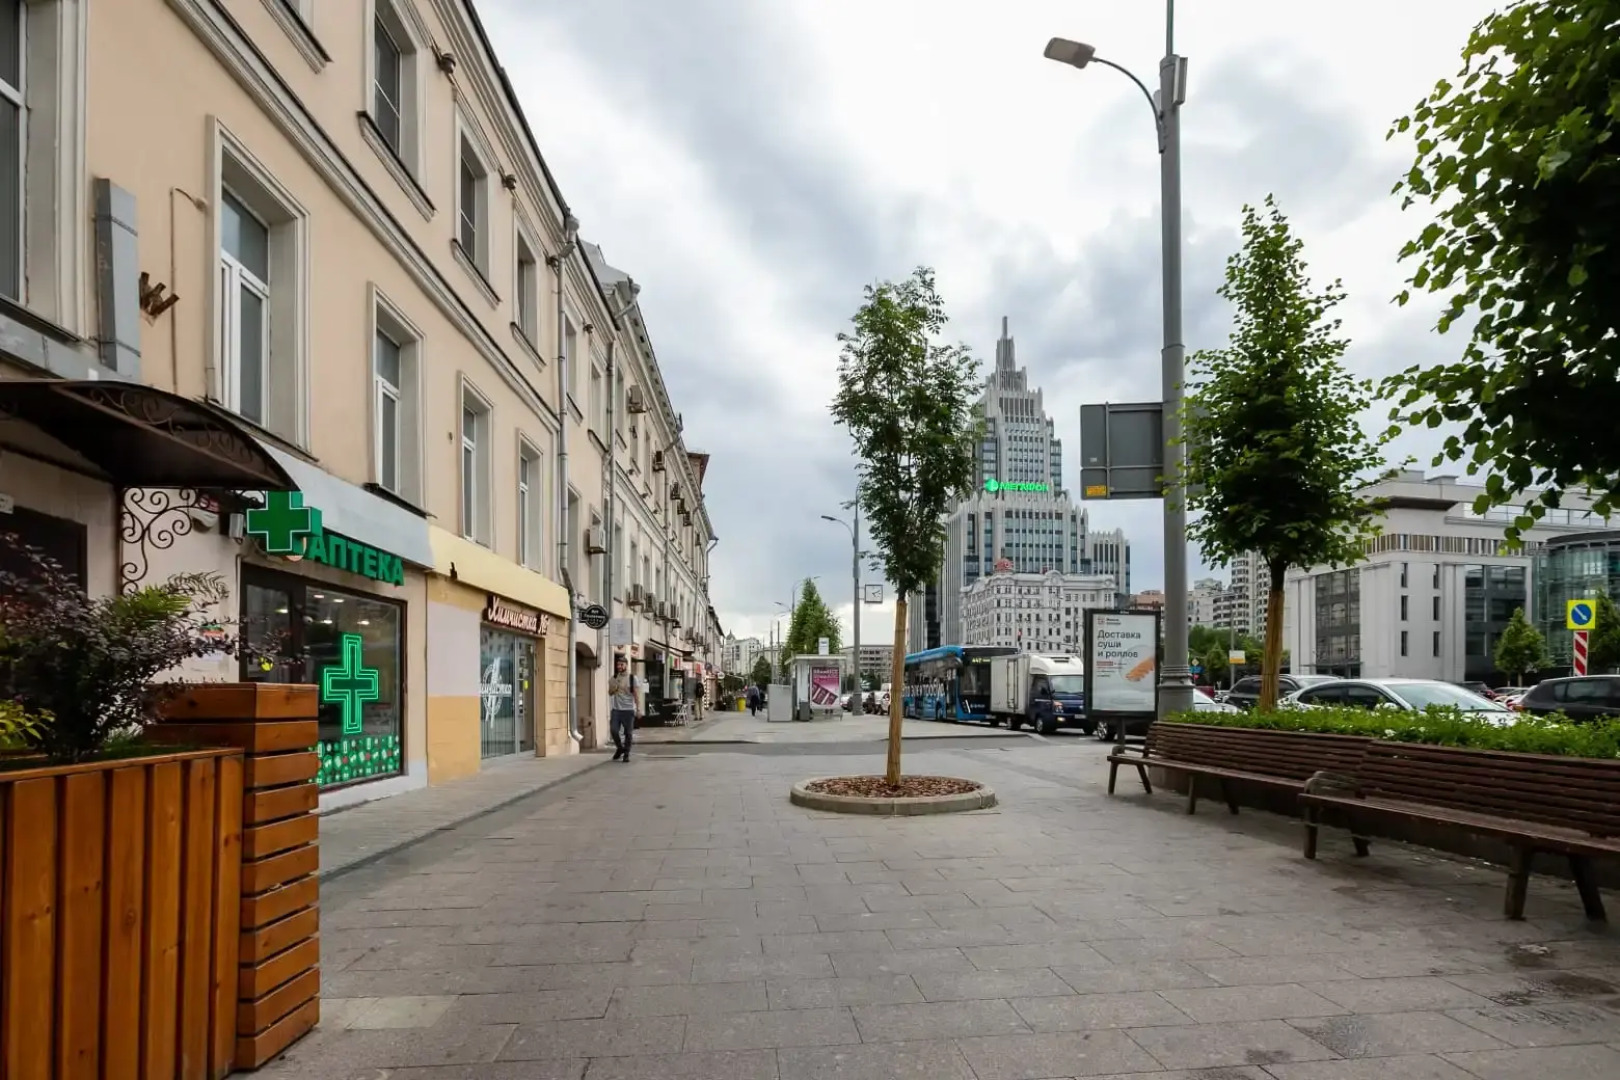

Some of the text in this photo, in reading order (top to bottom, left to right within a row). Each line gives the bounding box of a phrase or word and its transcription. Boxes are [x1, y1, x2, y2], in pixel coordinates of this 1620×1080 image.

[307, 535, 404, 585] АПТЕКА
[487, 596, 537, 632] Химчистка
[1097, 630, 1141, 639] Доставка
[1097, 641, 1122, 649] суши
[1105, 651, 1138, 659] роллов
